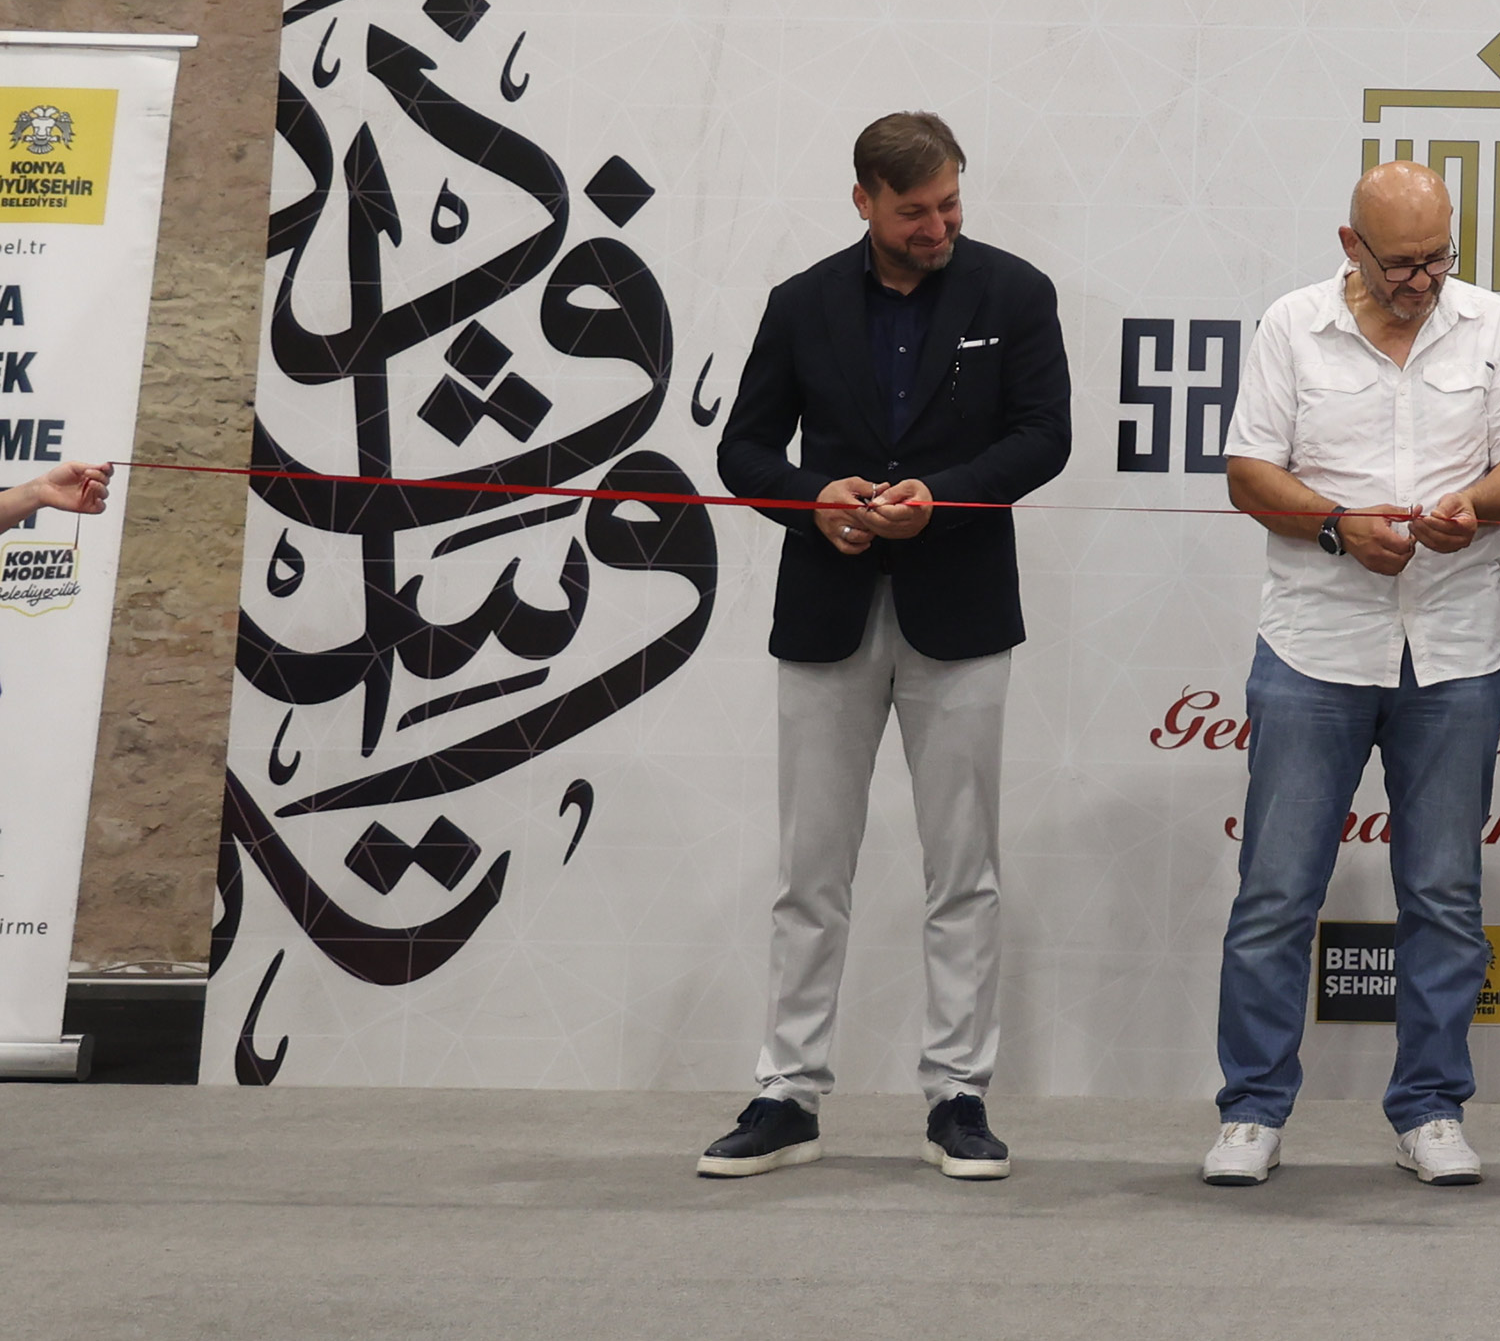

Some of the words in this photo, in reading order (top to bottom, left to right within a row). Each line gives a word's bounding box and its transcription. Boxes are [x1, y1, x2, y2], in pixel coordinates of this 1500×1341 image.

[10, 161, 66, 174] KONYA
[0, 175, 93, 196] YÜKŞEHİR
[1, 196, 67, 208] BELEDİYESİ
[0, 239, 47, 255] el.tr
[5, 549, 74, 566] KONYA
